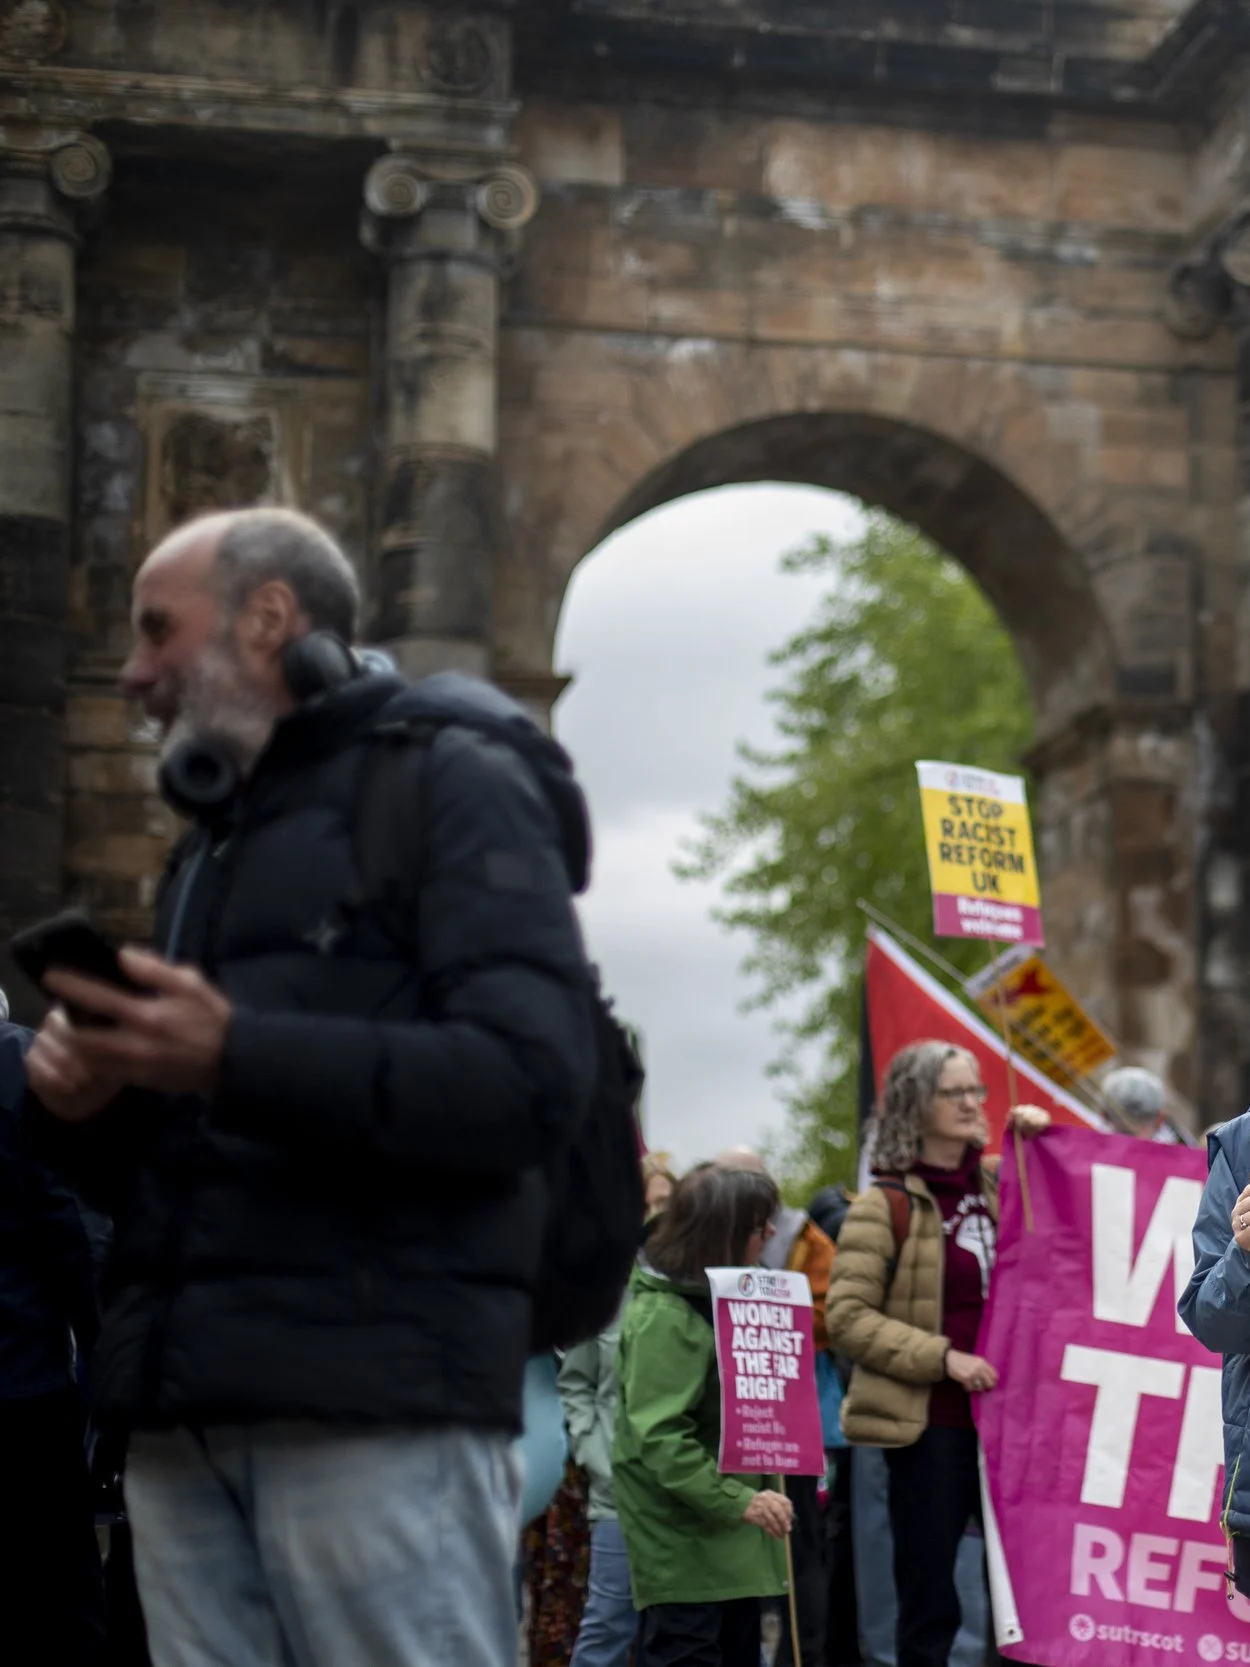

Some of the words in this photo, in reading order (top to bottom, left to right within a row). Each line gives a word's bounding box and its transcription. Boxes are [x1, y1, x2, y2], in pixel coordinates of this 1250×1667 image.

[948, 796, 1005, 820] STOP
[940, 818, 1016, 847] RACIST
[939, 842, 1025, 874] REFORM
[972, 870, 1002, 893] UK
[728, 1301, 794, 1330] WOMEN
[731, 1326, 804, 1356] AGAINST
[732, 1350, 772, 1375] THE
[735, 1375, 786, 1402] RIGHT
[1097, 1624, 1185, 1654] sutrscot
